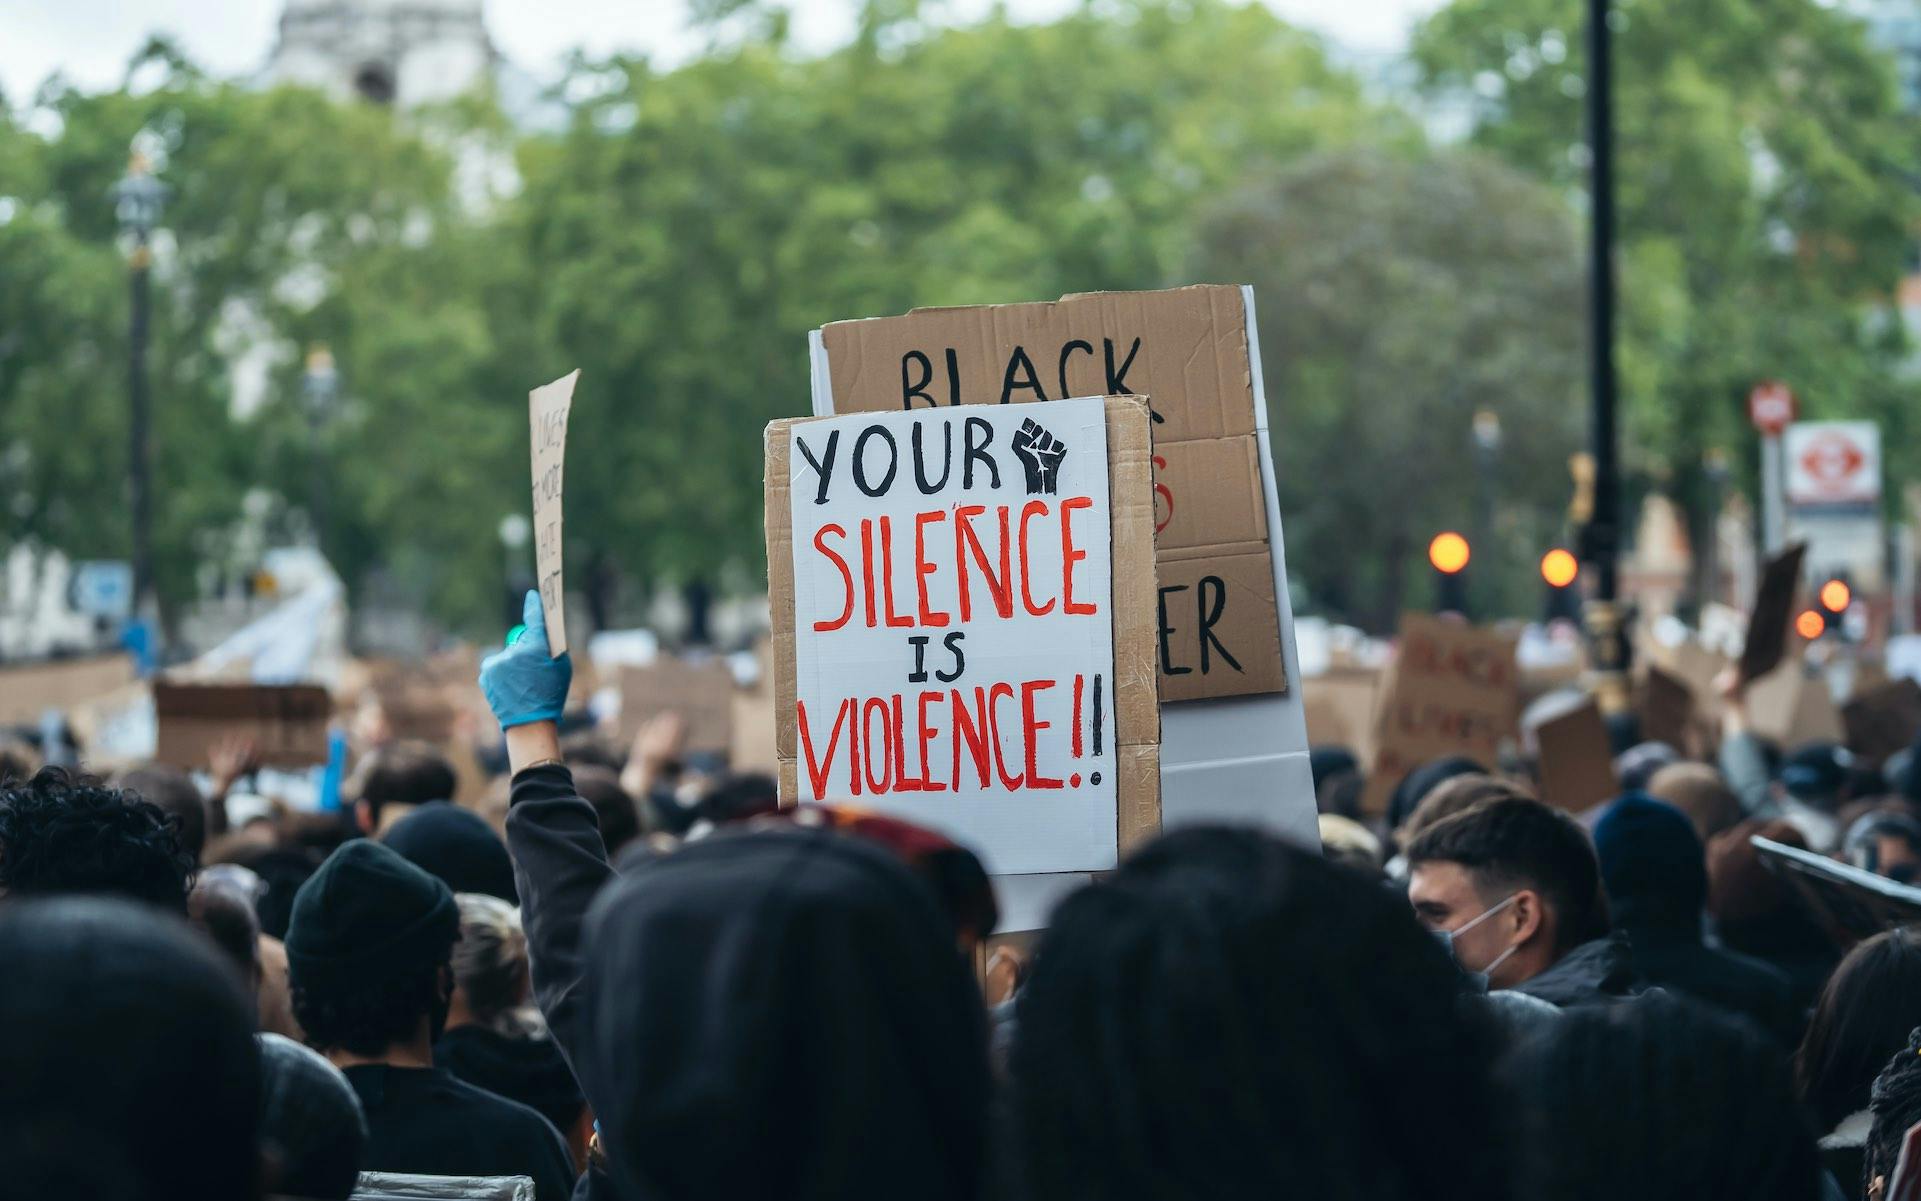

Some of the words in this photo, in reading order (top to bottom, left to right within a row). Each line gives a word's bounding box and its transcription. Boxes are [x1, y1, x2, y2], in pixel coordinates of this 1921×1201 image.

[902, 337, 1165, 424] BLACK
[797, 416, 1001, 505] YOUR
[813, 496, 1097, 632] SILENCE
[908, 631, 965, 683] IS
[797, 673, 1103, 801] VIOLENCE!!
